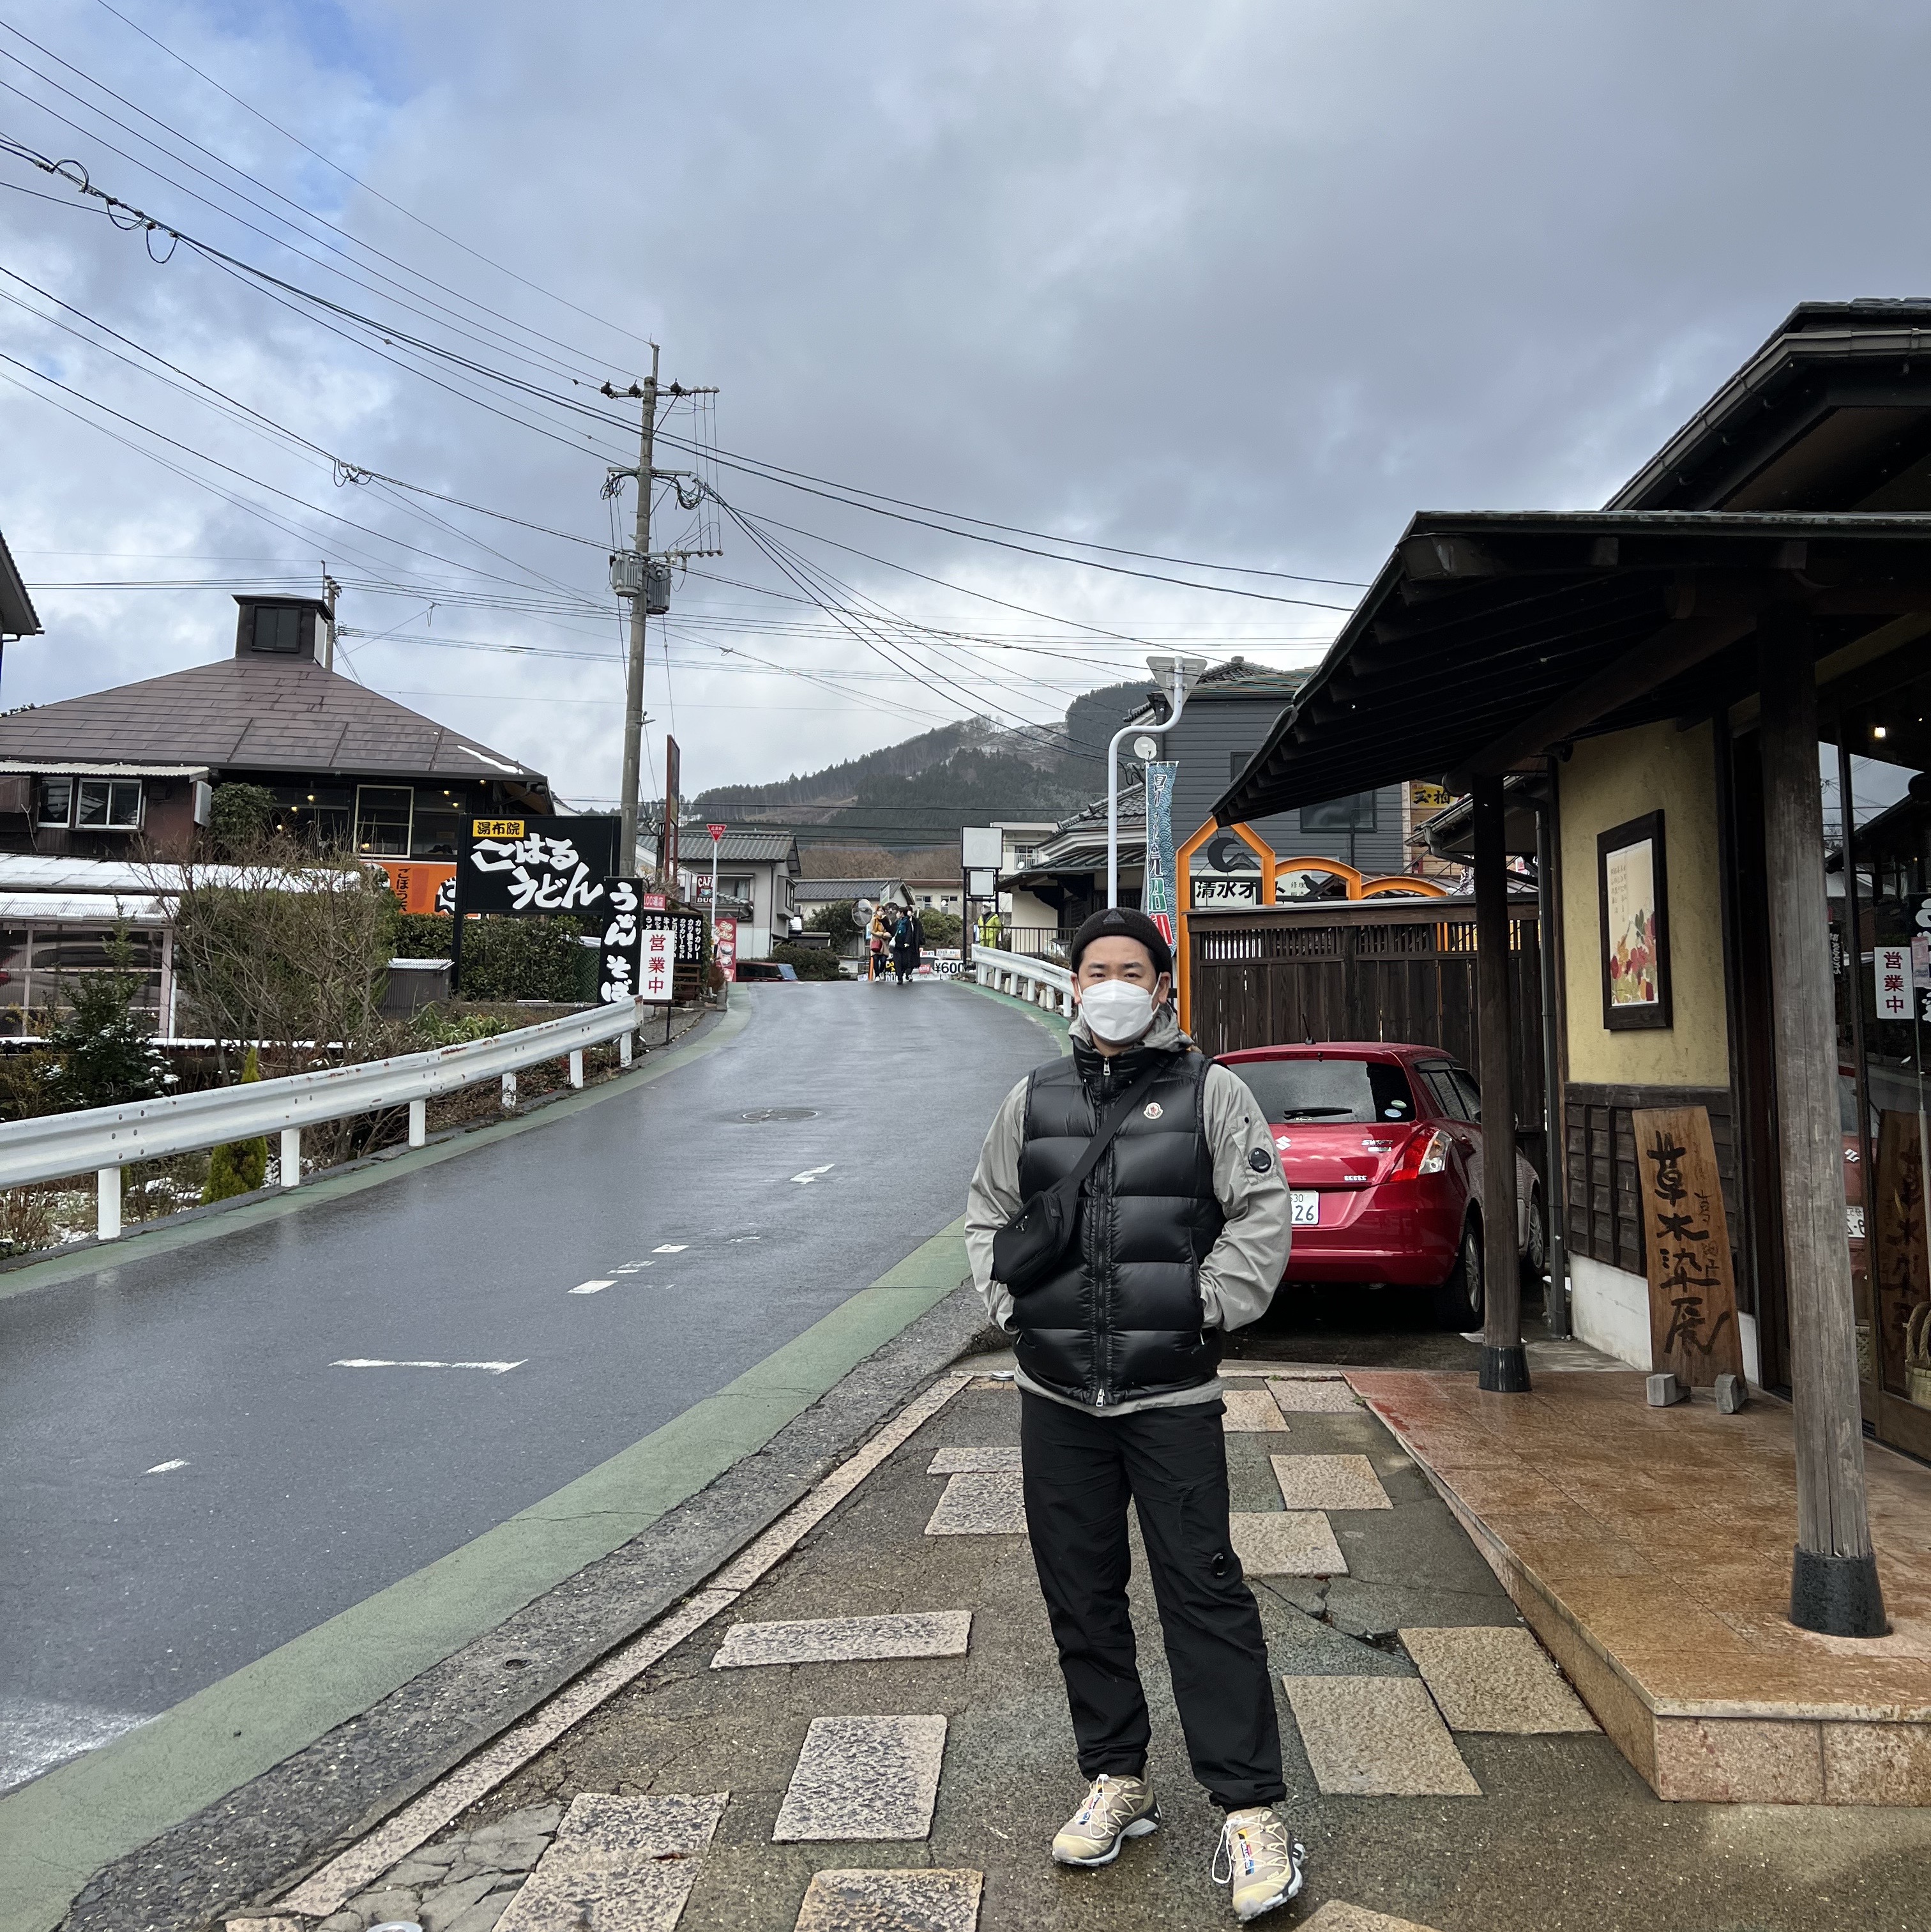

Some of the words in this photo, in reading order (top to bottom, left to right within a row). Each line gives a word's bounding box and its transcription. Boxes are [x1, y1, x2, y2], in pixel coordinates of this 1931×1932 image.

[477, 821, 520, 835] 湯布院
[471, 833, 579, 871] こはる
[507, 862, 603, 909] うどん
[604, 882, 638, 946] うどん
[648, 934, 666, 994] 営業中
